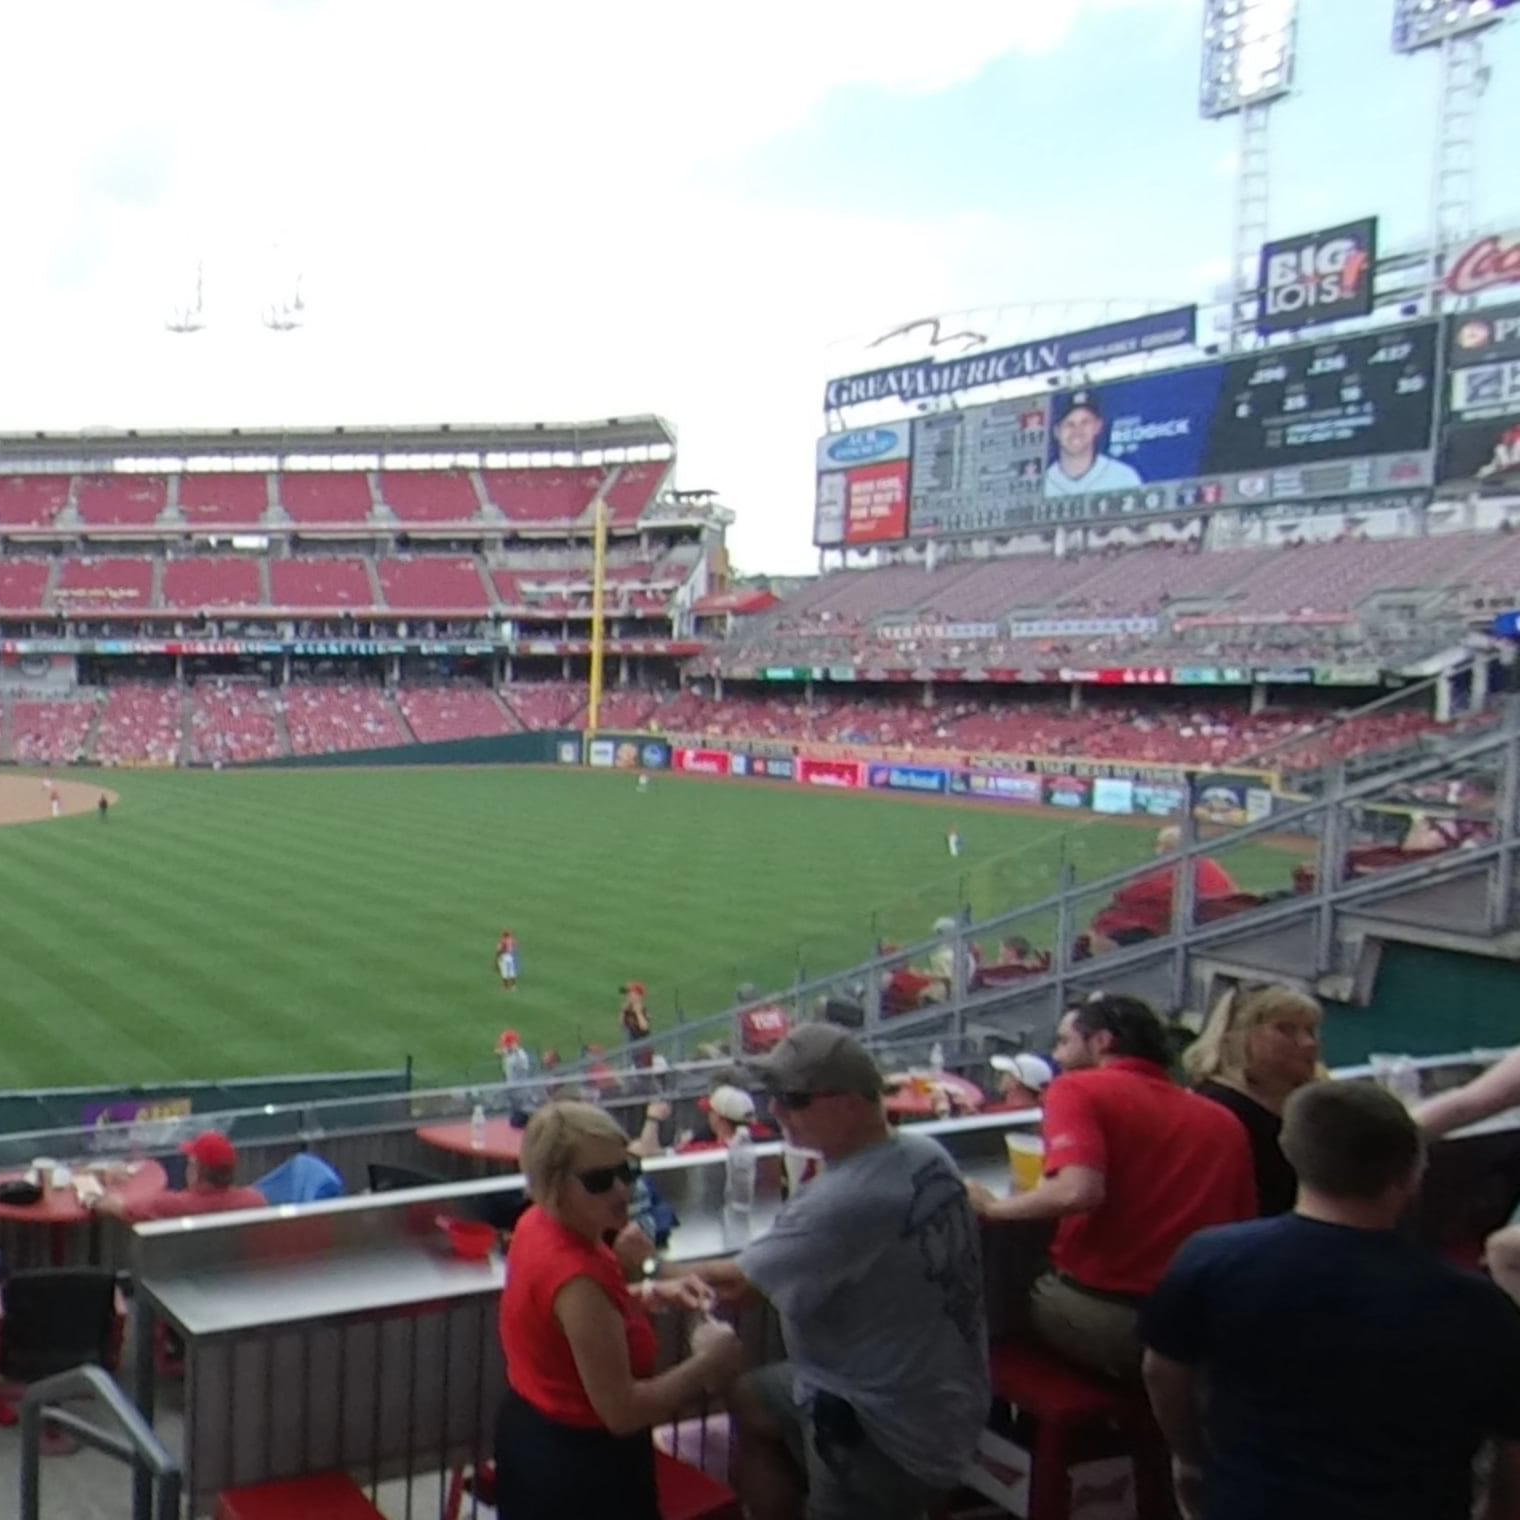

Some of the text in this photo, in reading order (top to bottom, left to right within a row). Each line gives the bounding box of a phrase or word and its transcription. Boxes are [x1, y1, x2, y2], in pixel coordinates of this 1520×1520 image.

[1267, 238, 1356, 288] BIG
[826, 367, 913, 406] GREAT
[903, 344, 1061, 400] AMERICAN
